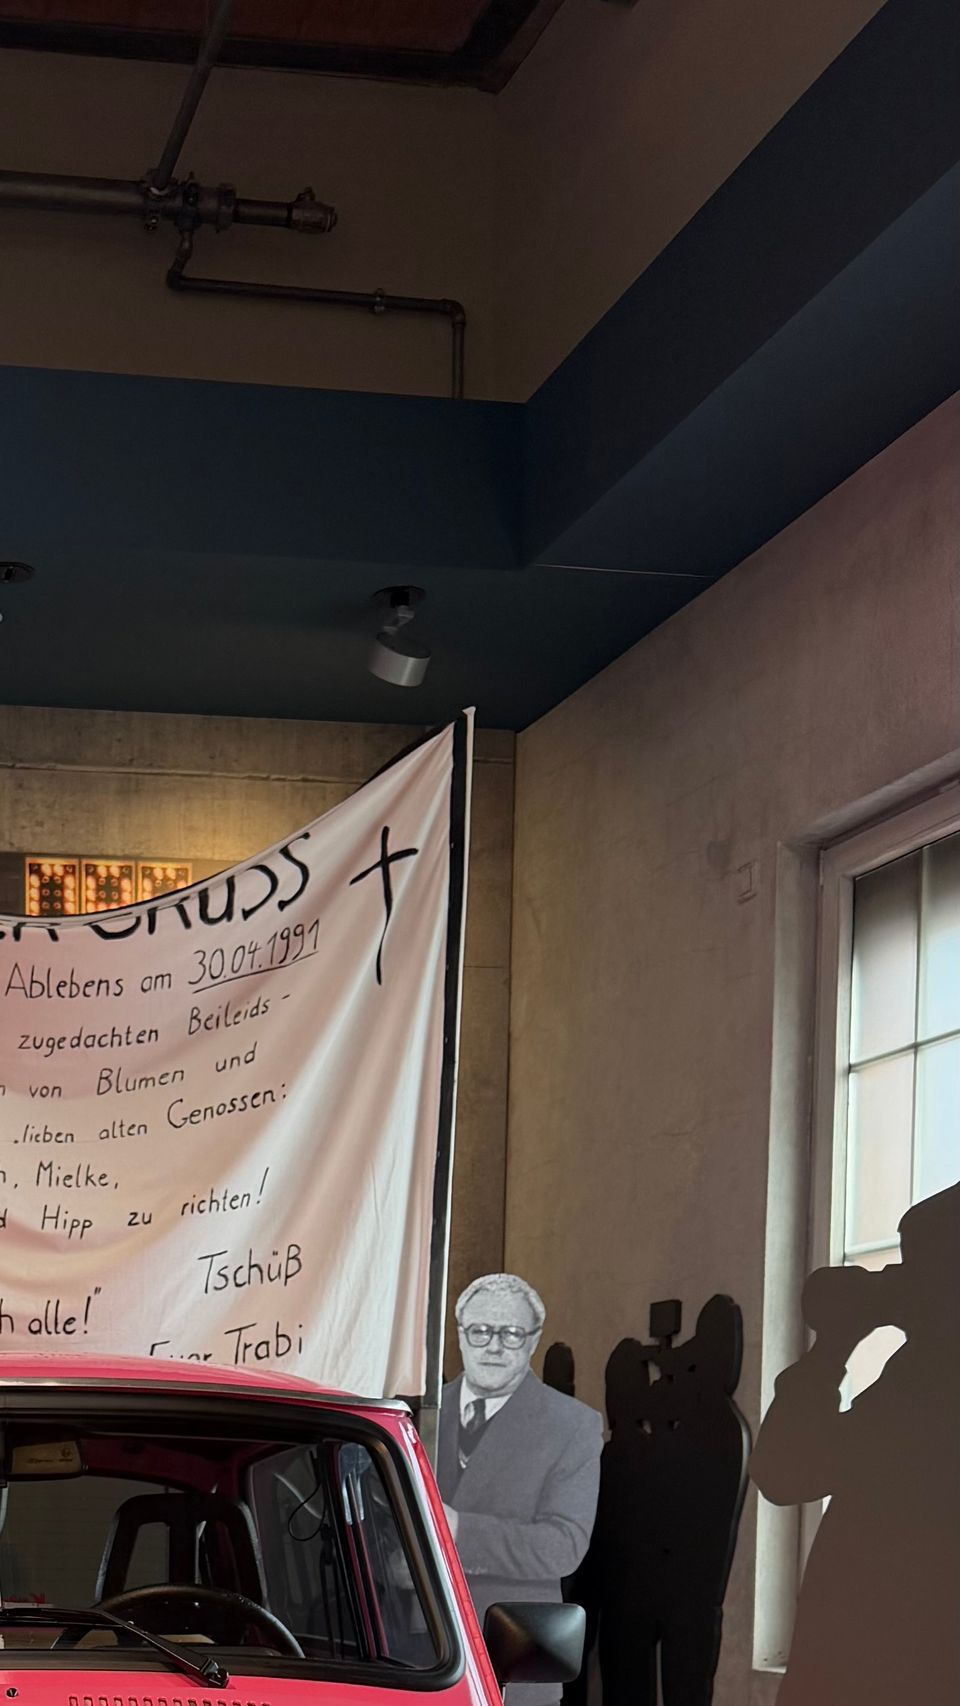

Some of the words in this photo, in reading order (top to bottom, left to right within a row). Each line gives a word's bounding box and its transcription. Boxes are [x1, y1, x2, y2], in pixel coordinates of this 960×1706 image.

[4, 961, 124, 1000] Ablebens
[140, 972, 172, 994] am
[188, 918, 320, 990] 30.04.1991
[17, 1026, 159, 1058] zugedachten
[28, 1084, 62, 1098] von
[96, 1066, 185, 1096] Blumen
[215, 1041, 258, 1073] und
[98, 1120, 148, 1141] alten
[166, 1083, 288, 1129] Genossen:
[35, 1160, 119, 1190] Mielke,
[41, 1204, 94, 1240] Hipp
[127, 1211, 153, 1227] zu
[180, 1166, 270, 1217] richten!
[197, 1243, 303, 1295] Tschüß
[223, 1321, 304, 1366] Trabi
